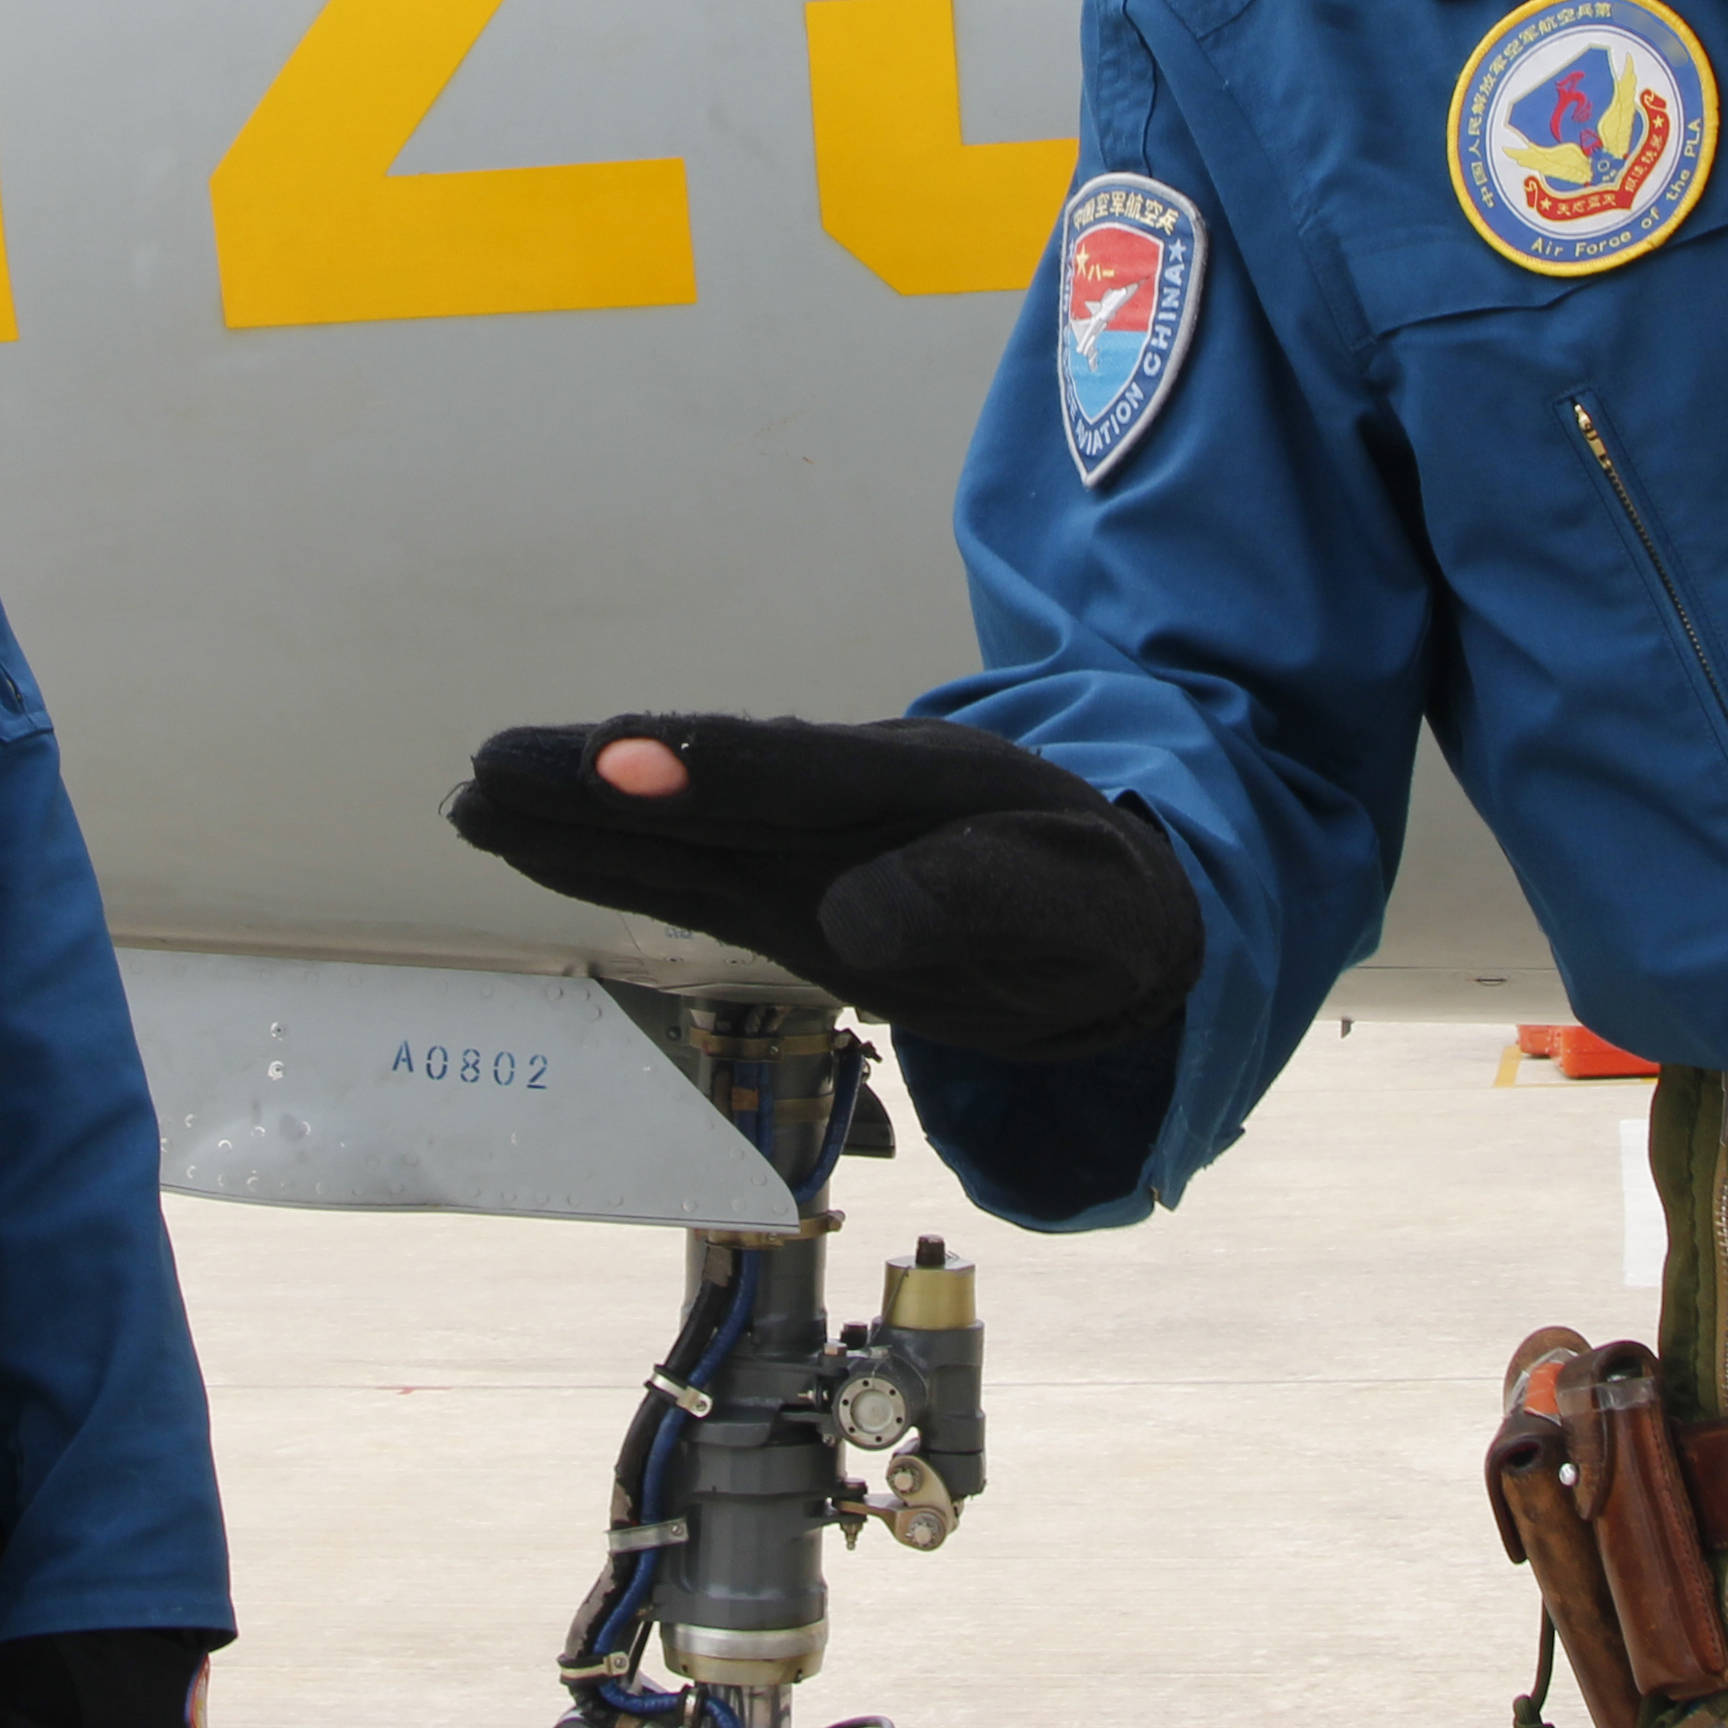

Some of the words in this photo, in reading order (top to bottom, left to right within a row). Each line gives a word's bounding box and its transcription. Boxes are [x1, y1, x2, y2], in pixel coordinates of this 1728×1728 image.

[1531, 237, 1564, 257] Air
[1575, 230, 1632, 257] Force
[1641, 207, 1661, 230] of
[1665, 169, 1691, 201] the
[1684, 118, 1702, 158] PLA
[1073, 190, 1180, 237] 中国空军航空兵
[1087, 264, 1116, 282] 八一
[1142, 258, 1186, 377] CHINA
[392, 1040, 549, 1090] A0802
